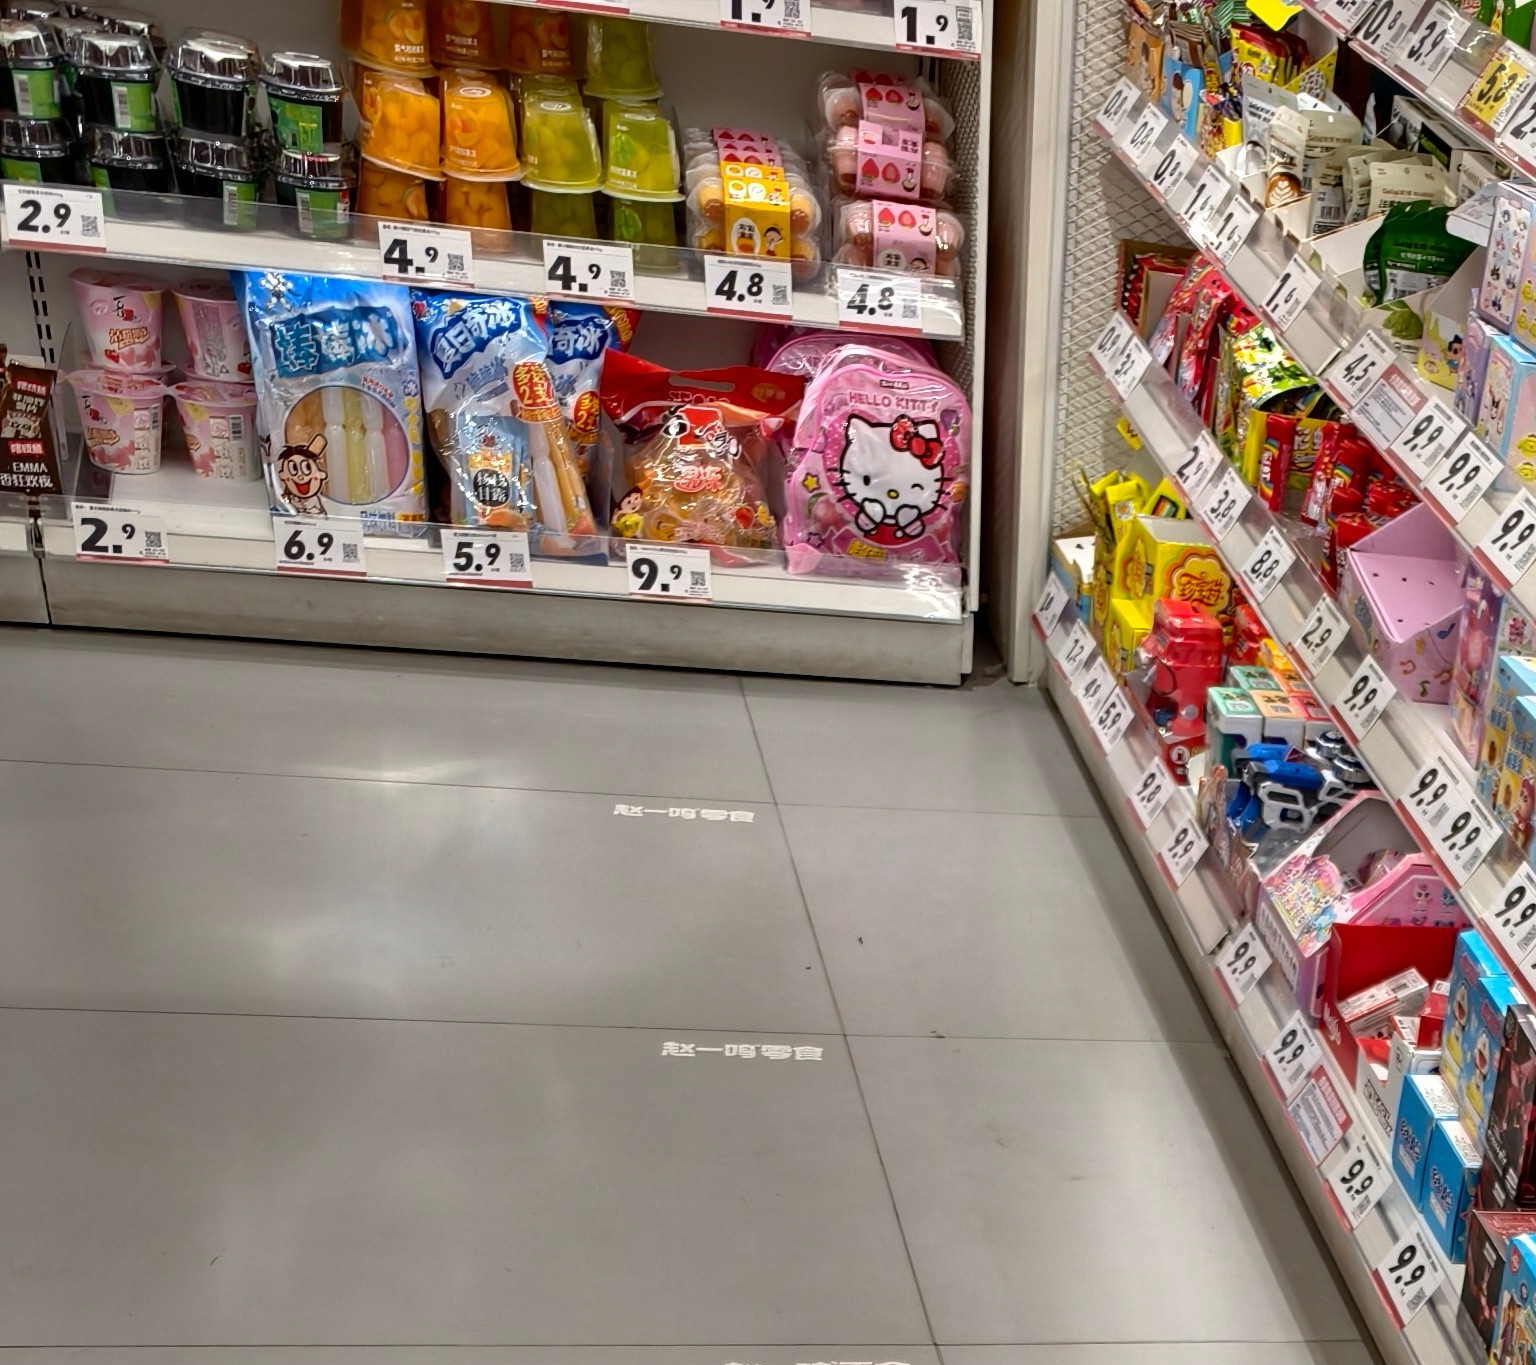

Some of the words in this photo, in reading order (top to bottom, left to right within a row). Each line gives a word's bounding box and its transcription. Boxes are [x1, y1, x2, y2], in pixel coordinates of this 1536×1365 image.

[902, 7, 948, 44] 1.9
[1408, 21, 1446, 62] 3.9
[18, 200, 71, 233] 2.9
[384, 239, 438, 273] 4.9
[548, 256, 601, 292] 4.9
[715, 270, 763, 301] 4.8
[847, 284, 894, 315] 4.8
[1343, 354, 1376, 382] 4.5
[848, 391, 891, 407] HELLO
[1403, 415, 1433, 451] 9.9
[13, 462, 48, 472] EMMA
[1439, 453, 1480, 491] 9.9
[81, 518, 135, 553] 2.9
[284, 530, 333, 560] 6.9
[1498, 517, 1535, 560] 9.9
[454, 542, 500, 571] 5.9
[632, 558, 682, 592] 9.9
[1302, 626, 1333, 657] 2.9
[1350, 679, 1380, 713] 9.9
[1410, 769, 1447, 806] 9.9
[1168, 828, 1194, 858] 9.9
[1442, 812, 1480, 850] 9.9
[1495, 886, 1536, 927] 9.9
[1227, 942, 1256, 974] 9.9
[1276, 1027, 1306, 1067] 9.9
[1341, 1160, 1373, 1195] 9.9
[1389, 1245, 1425, 1286] 9.9
